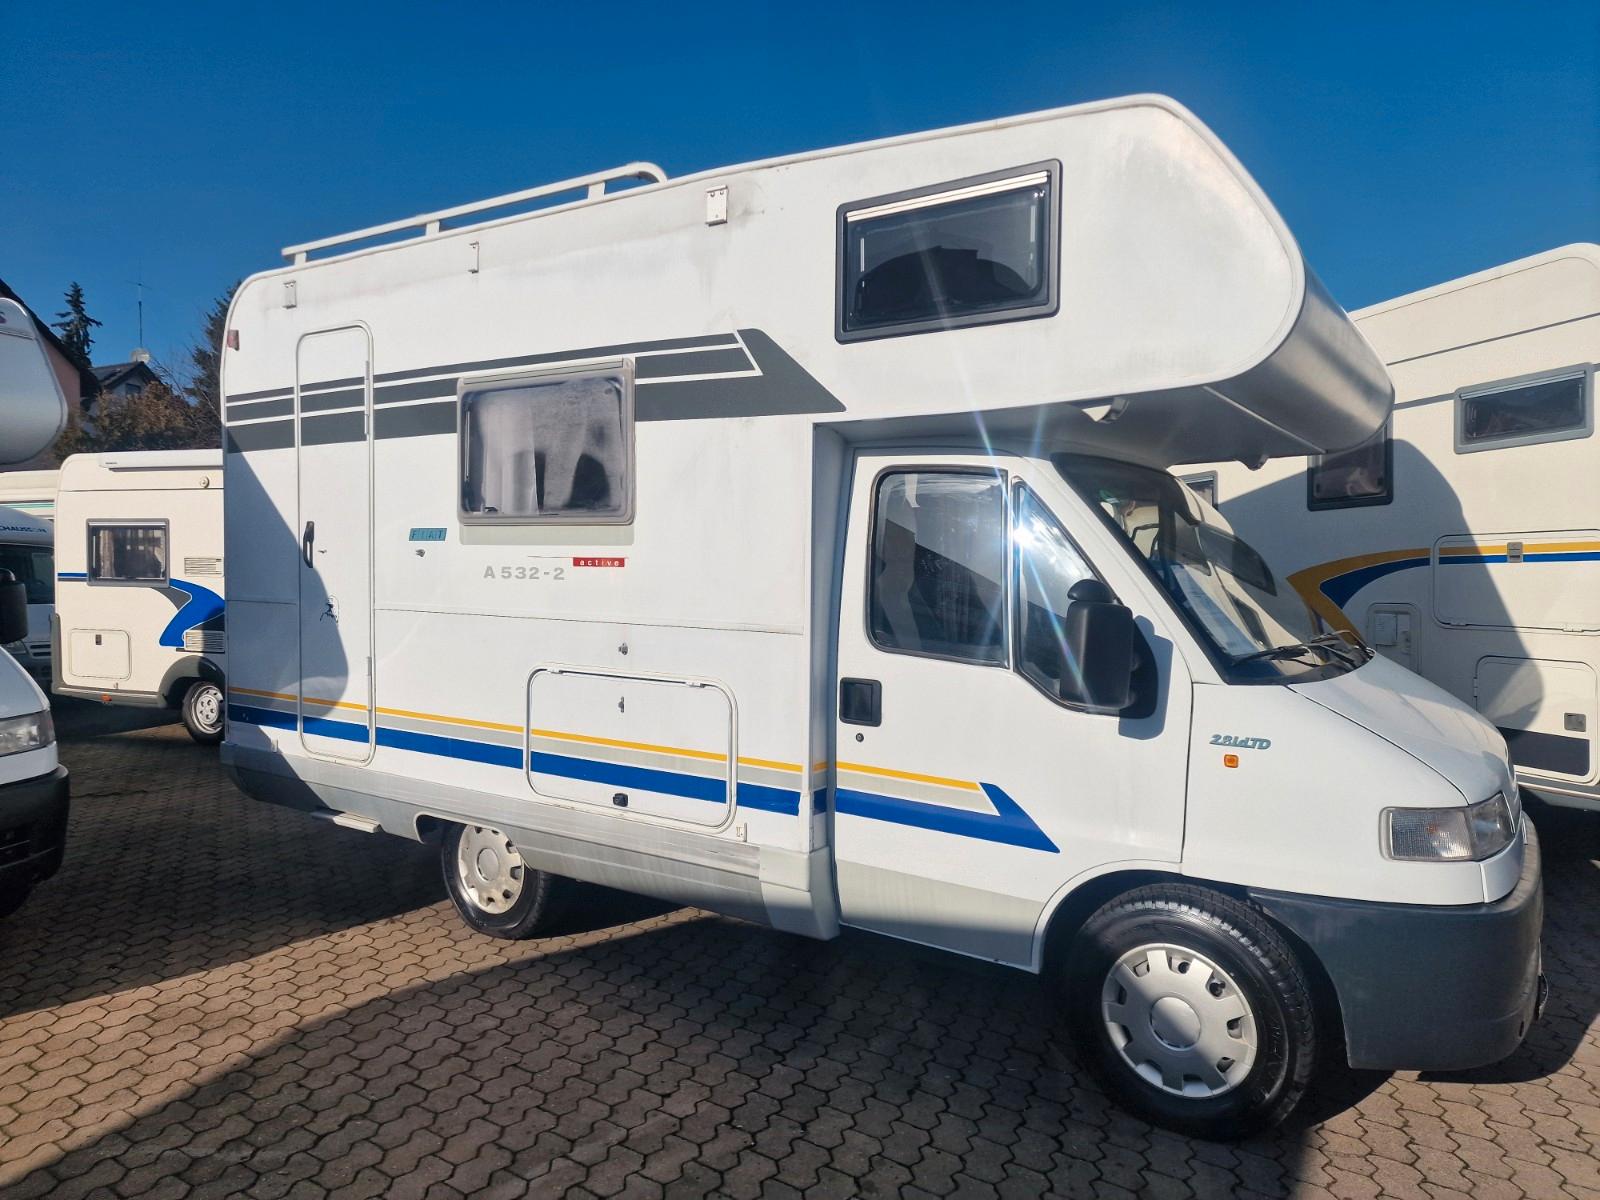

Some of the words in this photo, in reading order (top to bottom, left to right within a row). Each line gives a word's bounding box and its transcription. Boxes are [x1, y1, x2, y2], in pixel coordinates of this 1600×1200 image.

[410, 529, 445, 540] FIAT
[579, 558, 620, 567] active
[483, 565, 496, 579] A
[501, 566, 565, 580] 532-2
